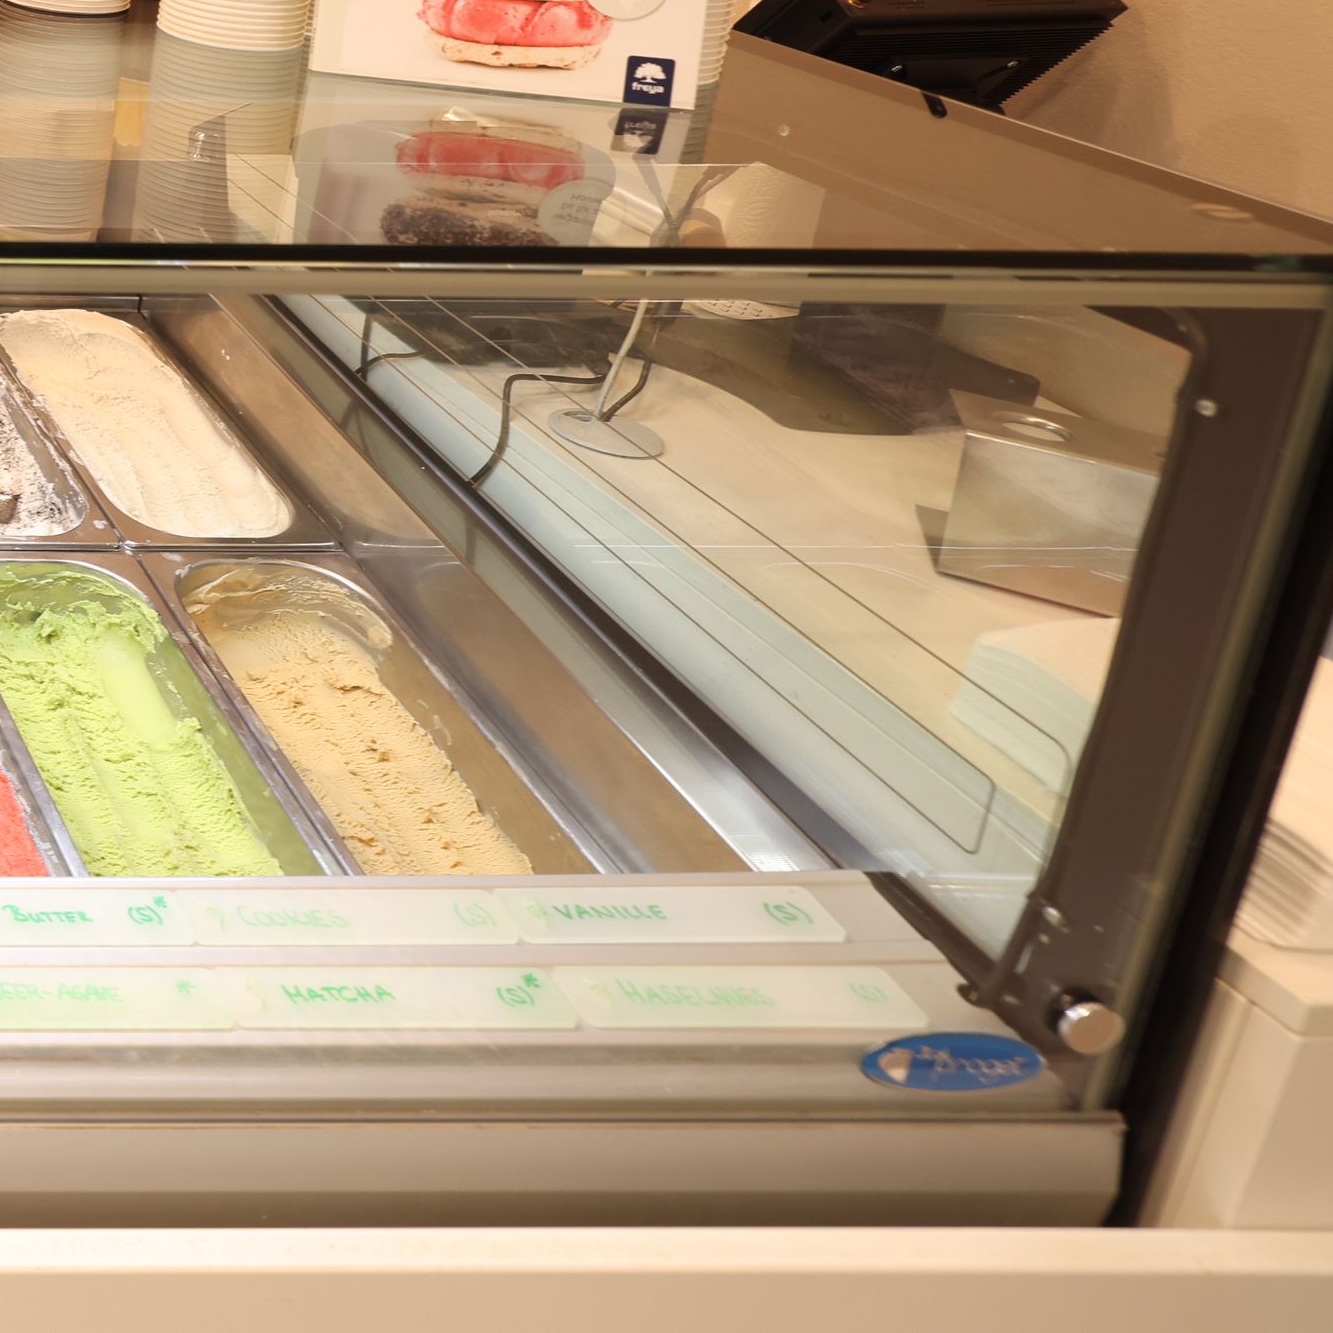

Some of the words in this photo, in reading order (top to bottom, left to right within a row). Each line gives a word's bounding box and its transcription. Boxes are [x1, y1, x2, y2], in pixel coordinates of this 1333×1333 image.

[631, 81, 665, 95] freya
[1, 903, 94, 924] BUTTER
[237, 903, 350, 929] COOKIES
[553, 904, 668, 922] VANILLE
[762, 901, 814, 926] (S)
[282, 984, 397, 1005] MATCHA
